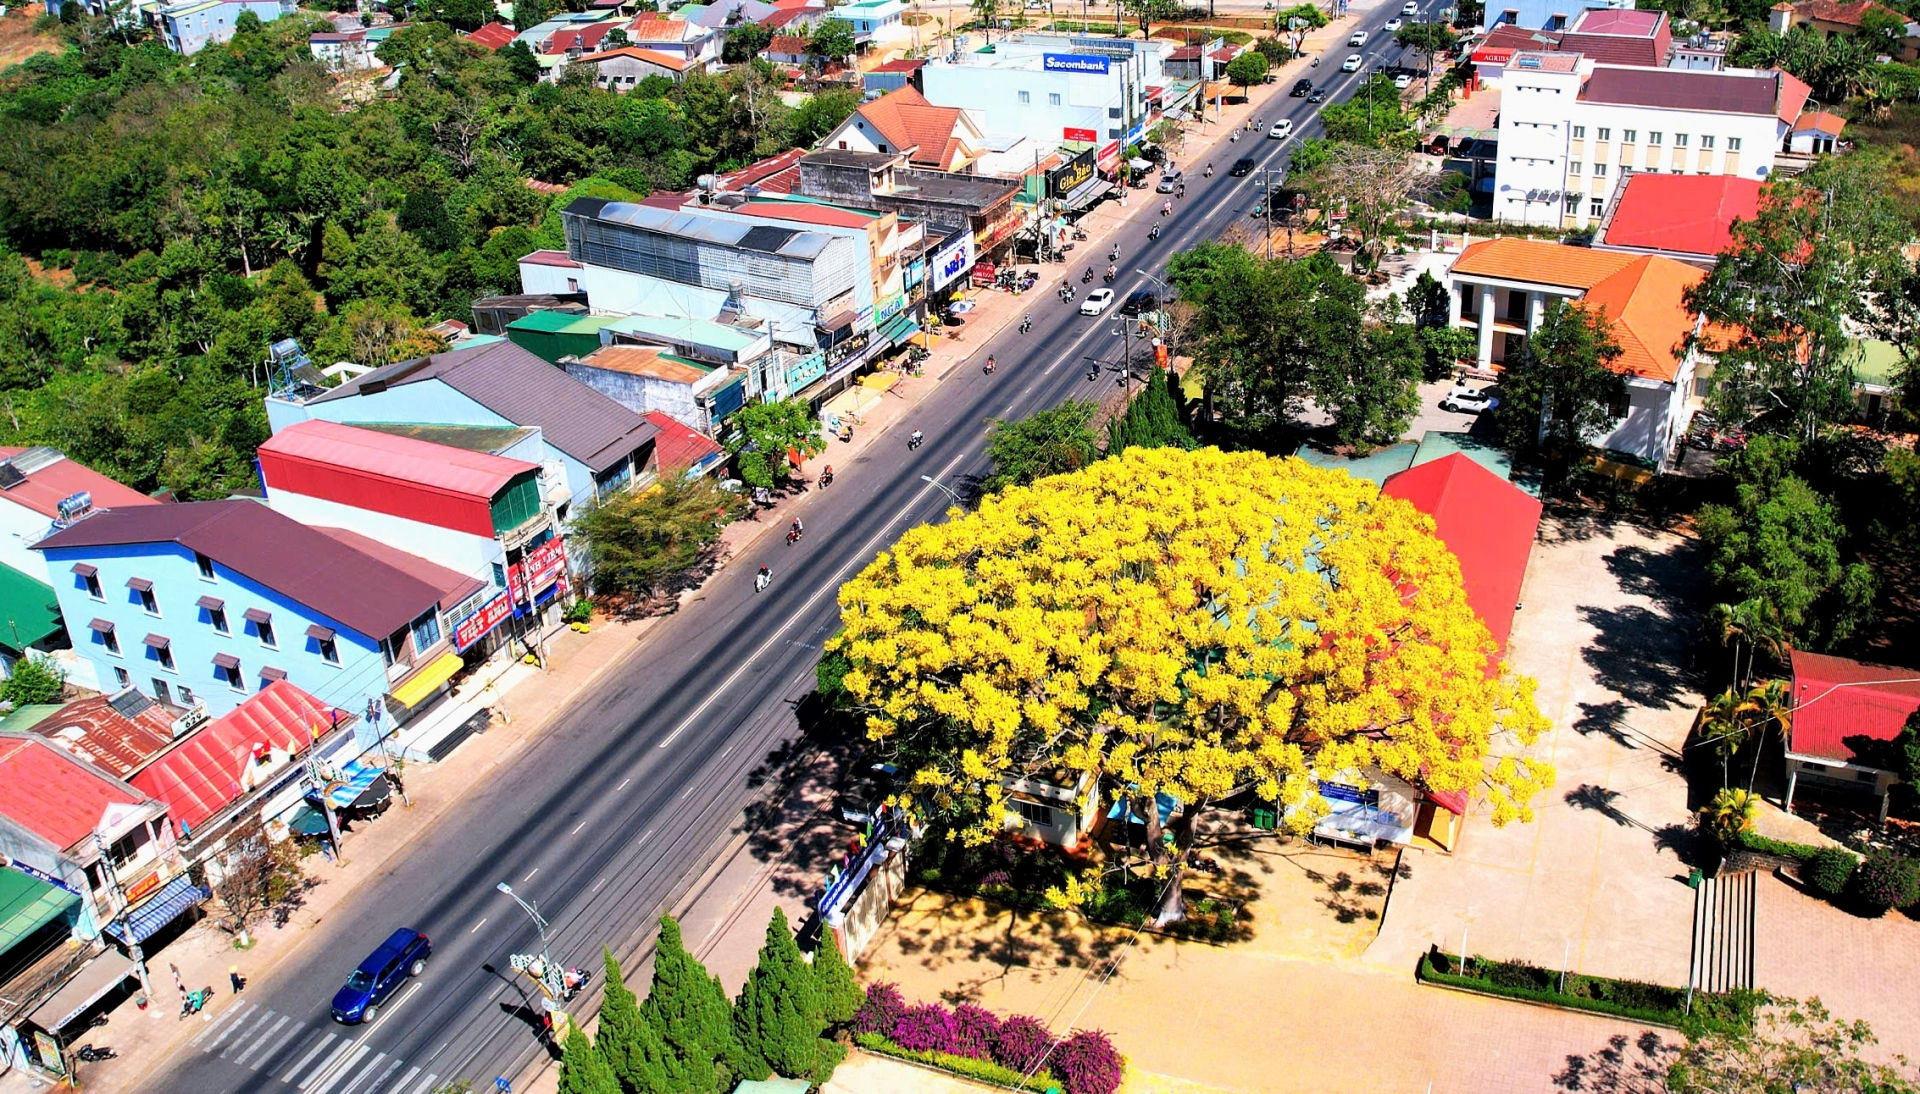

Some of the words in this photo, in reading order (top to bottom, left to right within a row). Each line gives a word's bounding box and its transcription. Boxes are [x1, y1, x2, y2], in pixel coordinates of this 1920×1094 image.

[1046, 57, 1105, 71] Sacombank
[1060, 174, 1074, 190] Gia
[880, 300, 901, 319] NGA
[487, 600, 508, 624] ANH
[186, 713, 202, 728] 629
